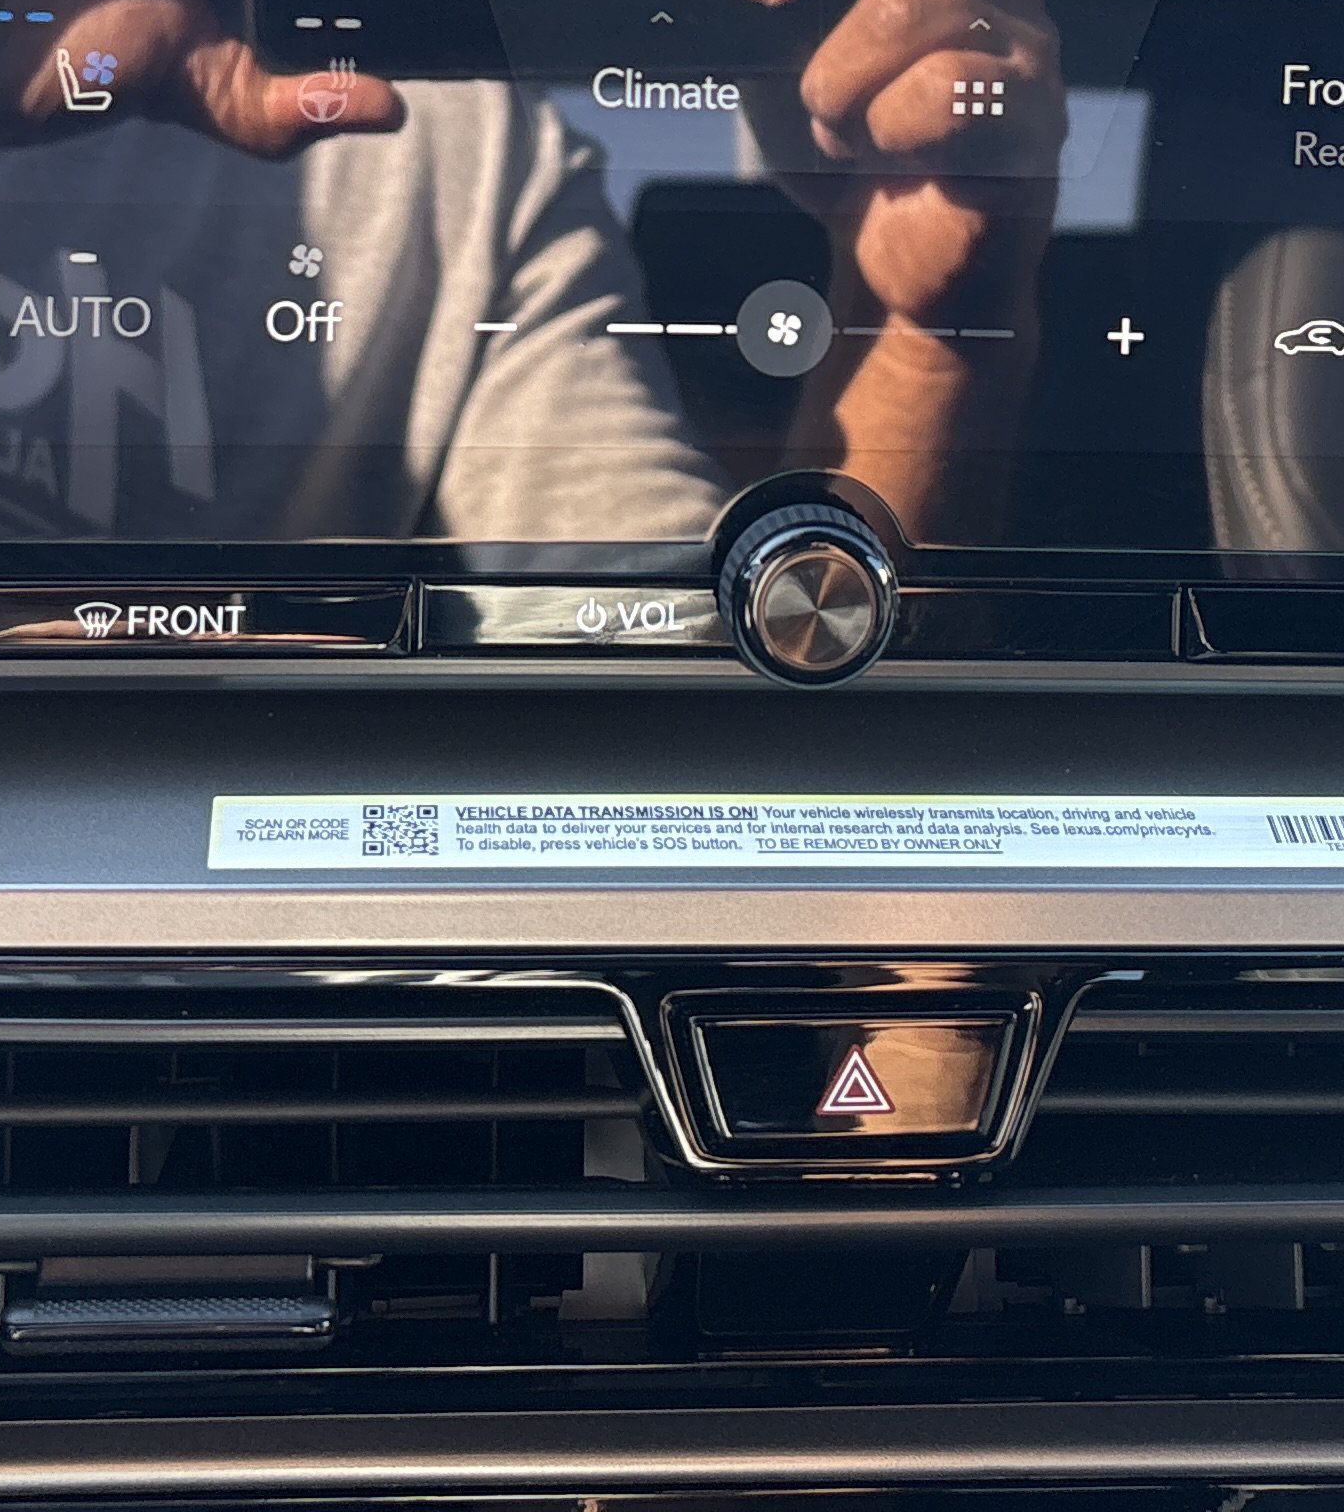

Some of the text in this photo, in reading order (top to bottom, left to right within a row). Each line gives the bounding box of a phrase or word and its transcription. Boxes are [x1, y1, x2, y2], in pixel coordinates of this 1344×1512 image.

[592, 67, 740, 112] Climate
[9, 296, 152, 338] AUTO
[265, 299, 345, 344] Off
[127, 605, 247, 636] FRONT
[617, 601, 686, 631] VOL
[455, 806, 528, 820] VEHICLE
[532, 806, 575, 820] DATA
[578, 806, 704, 820] TRANSMISSION
[709, 806, 724, 820] IS
[762, 806, 796, 820] Your
[800, 806, 851, 820] vehicle
[854, 806, 924, 821] wirelessly
[928, 807, 994, 820] transmits
[1062, 808, 1111, 822] driving
[1115, 808, 1141, 820] and
[1145, 808, 1196, 820] vehicle
[245, 819, 350, 830] SCAN QR CODE
[456, 823, 502, 835] health
[506, 823, 538, 835] data
[542, 823, 557, 835] to
[561, 823, 610, 835] deliver
[615, 825, 647, 839] your
[651, 823, 712, 835] services
[716, 823, 743, 835] and
[747, 823, 767, 835] for
[771, 822, 825, 835] internal
[829, 822, 893, 835] research
[897, 823, 923, 835] and
[928, 823, 959, 835] data
[964, 823, 1028, 837] analysis.
[1031, 823, 1060, 835] See
[237, 830, 350, 840] TO LEARN MORE
[458, 837, 743, 853] To disable, press vehicle's SOS button.
[757, 839, 1002, 850] TO BE REMOVED BY OWNER ONLY
